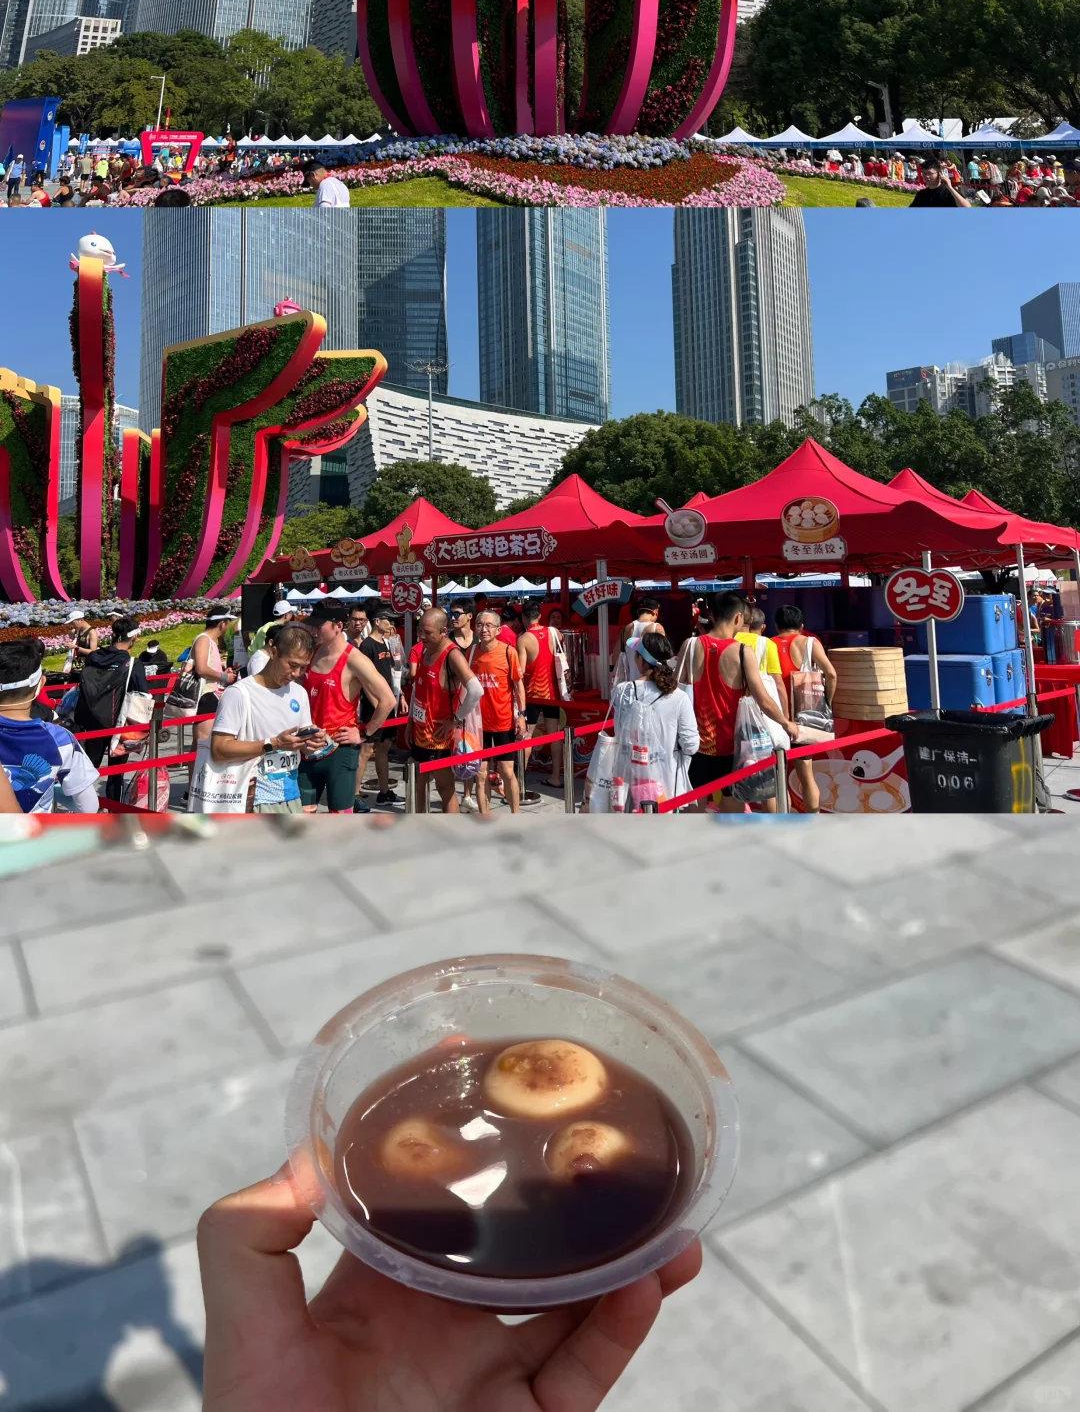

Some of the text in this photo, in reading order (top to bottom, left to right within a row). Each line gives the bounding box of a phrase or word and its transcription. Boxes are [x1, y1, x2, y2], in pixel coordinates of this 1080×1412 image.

[438, 533, 541, 560] 大湾区特色茶点
[670, 549, 708, 560] 冬至汤圆
[790, 543, 836, 555] 冬至蒸饺
[394, 586, 418, 606] 冬至
[583, 582, 619, 606] 好好味
[893, 577, 952, 611] 冬至
[267, 759, 274, 767] D
[937, 774, 974, 790] 006
